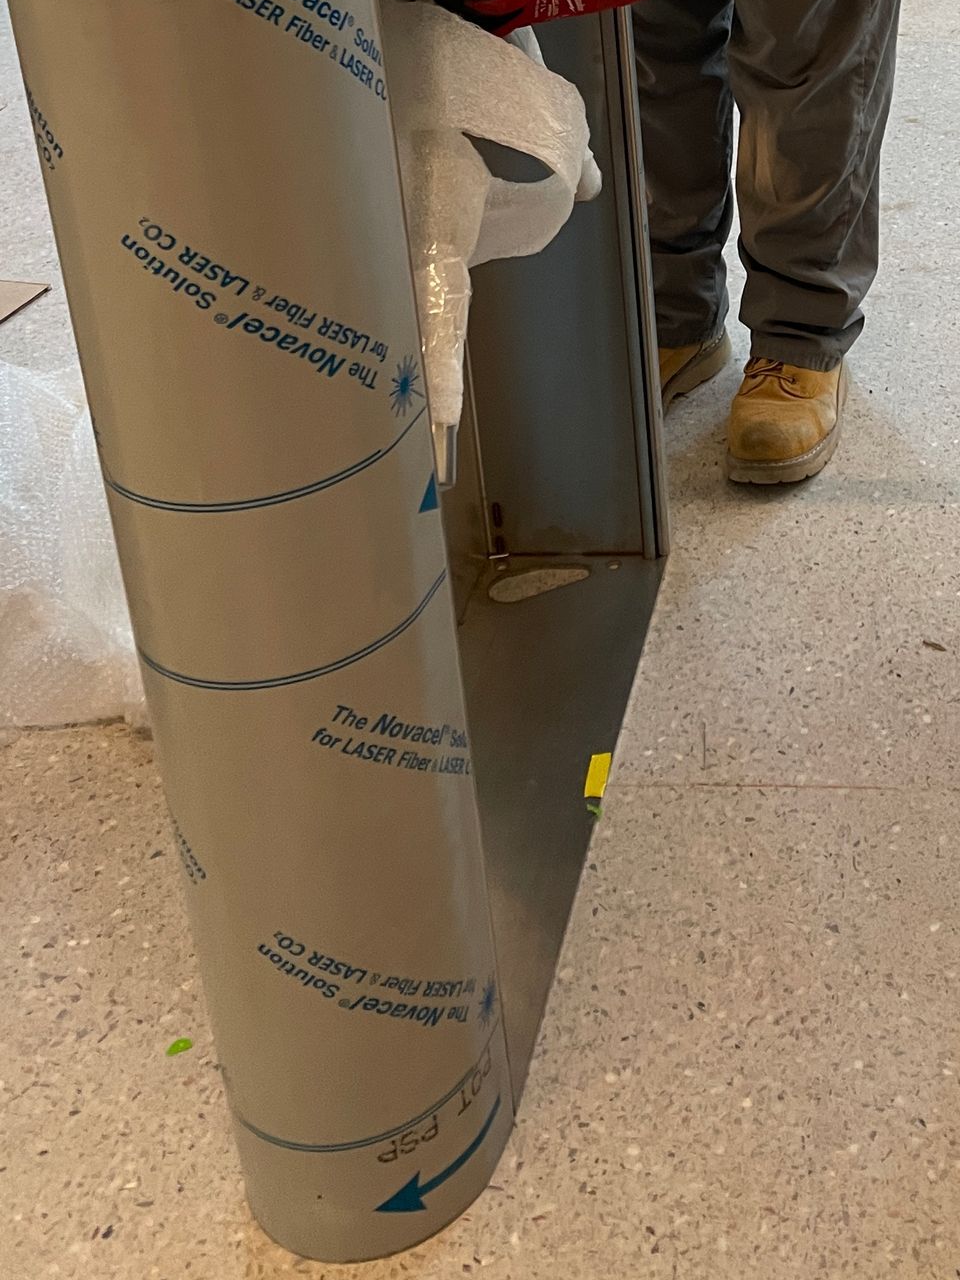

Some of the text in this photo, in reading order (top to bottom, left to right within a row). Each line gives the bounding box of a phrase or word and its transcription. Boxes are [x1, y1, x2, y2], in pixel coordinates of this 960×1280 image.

[285, 15, 331, 52] Fiber
[329, 44, 338, 61] &
[339, 48, 374, 89] LASER
[120, 234, 217, 310] Solution
[178, 245, 251, 296] LASER
[252, 286, 266, 301] &
[264, 295, 318, 329] Fiber
[318, 316, 373, 354] LASER
[373, 338, 389, 363] for
[350, 360, 379, 389] The
[331, 704, 368, 730] The
[311, 727, 343, 750] for
[340, 738, 398, 766] LASER
[397, 751, 432, 773] Fiber
[257, 944, 341, 999] Solution
[307, 951, 368, 984] LASER
[380, 976, 423, 996] Fiber
[423, 980, 464, 998] LASER
[377, 1115, 439, 1162] PSP
